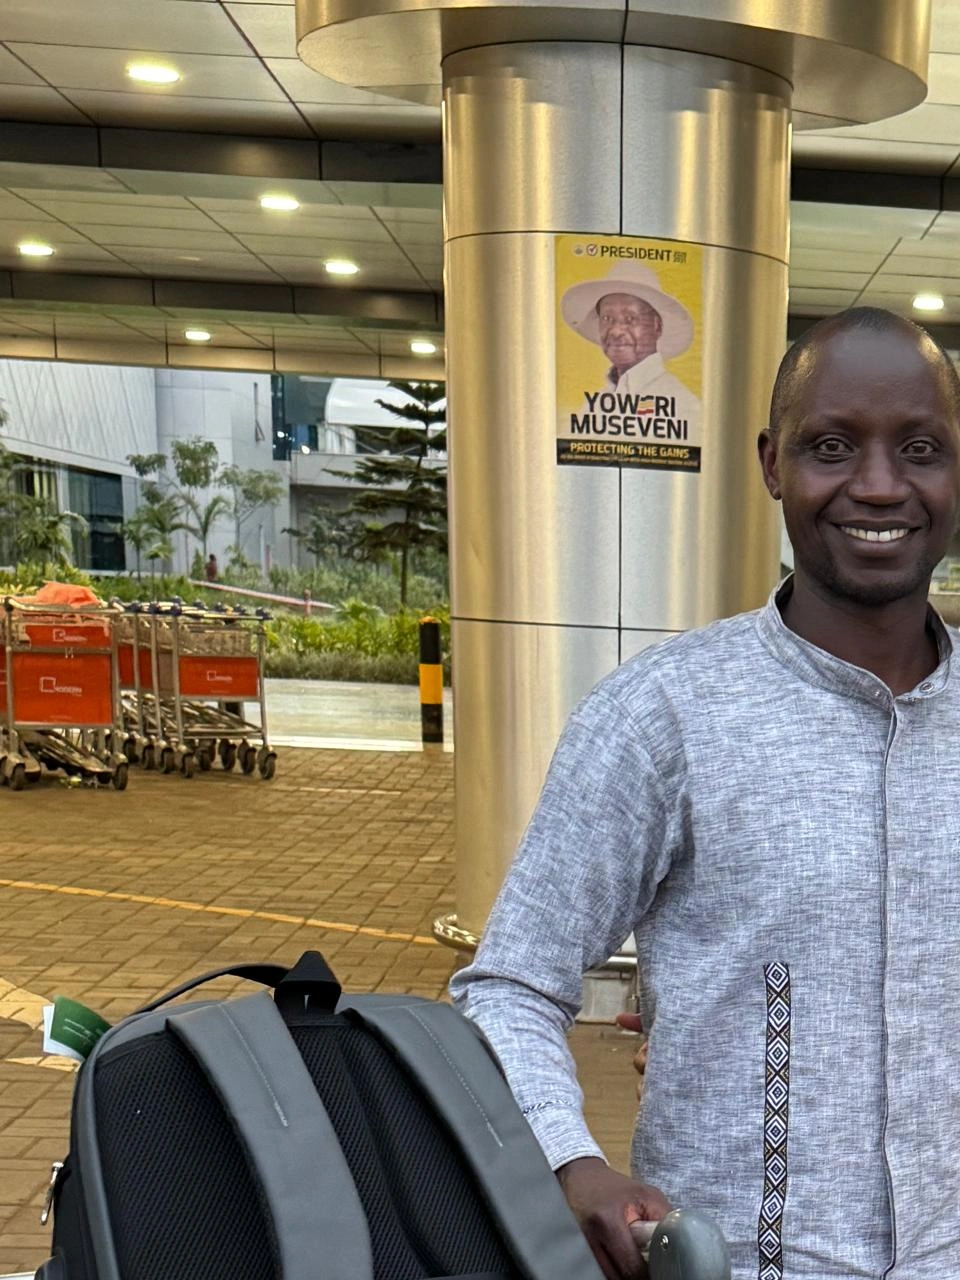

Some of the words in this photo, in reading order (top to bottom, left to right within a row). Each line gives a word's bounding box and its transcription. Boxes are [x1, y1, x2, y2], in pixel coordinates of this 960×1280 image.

[601, 245, 672, 262] PRESIDENT
[584, 391, 676, 418] YOWERI
[570, 413, 688, 440] MUSEVENI
[570, 442, 635, 456] PROTECTING
[638, 446, 658, 457] THE
[660, 447, 690, 459] GAINS
